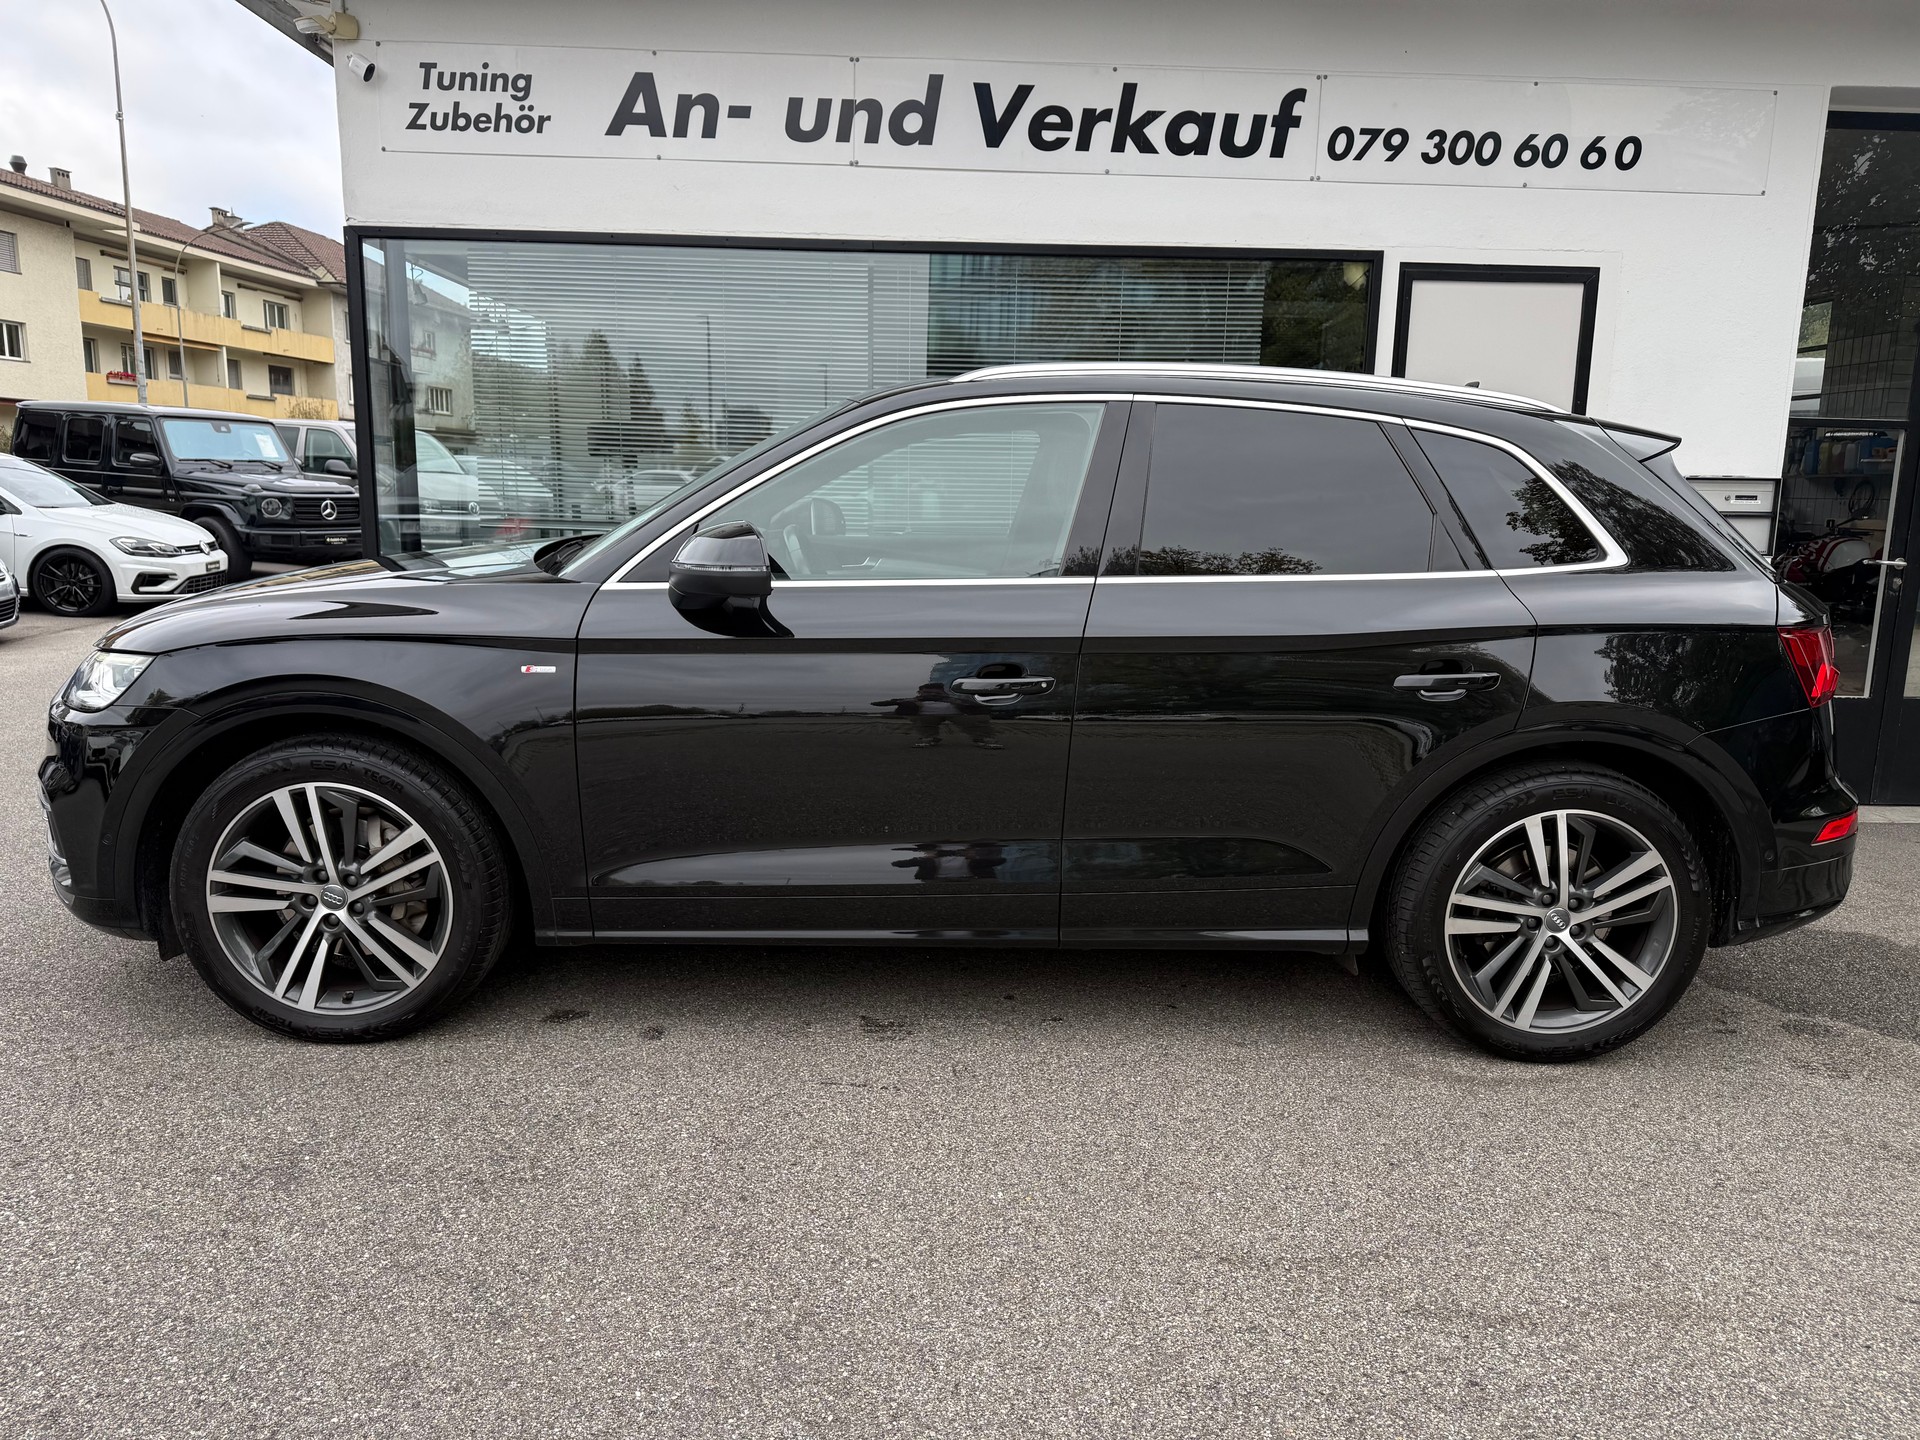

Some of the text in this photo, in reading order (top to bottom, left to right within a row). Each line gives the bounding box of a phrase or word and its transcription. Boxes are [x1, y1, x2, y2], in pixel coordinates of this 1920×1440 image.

[419, 61, 533, 102] Tuning
[404, 102, 552, 134] Zubehör
[604, 71, 1308, 159] An- und Verkauf
[1327, 125, 1410, 163] 079
[1420, 128, 1502, 167] 300
[1513, 133, 1569, 169] 60
